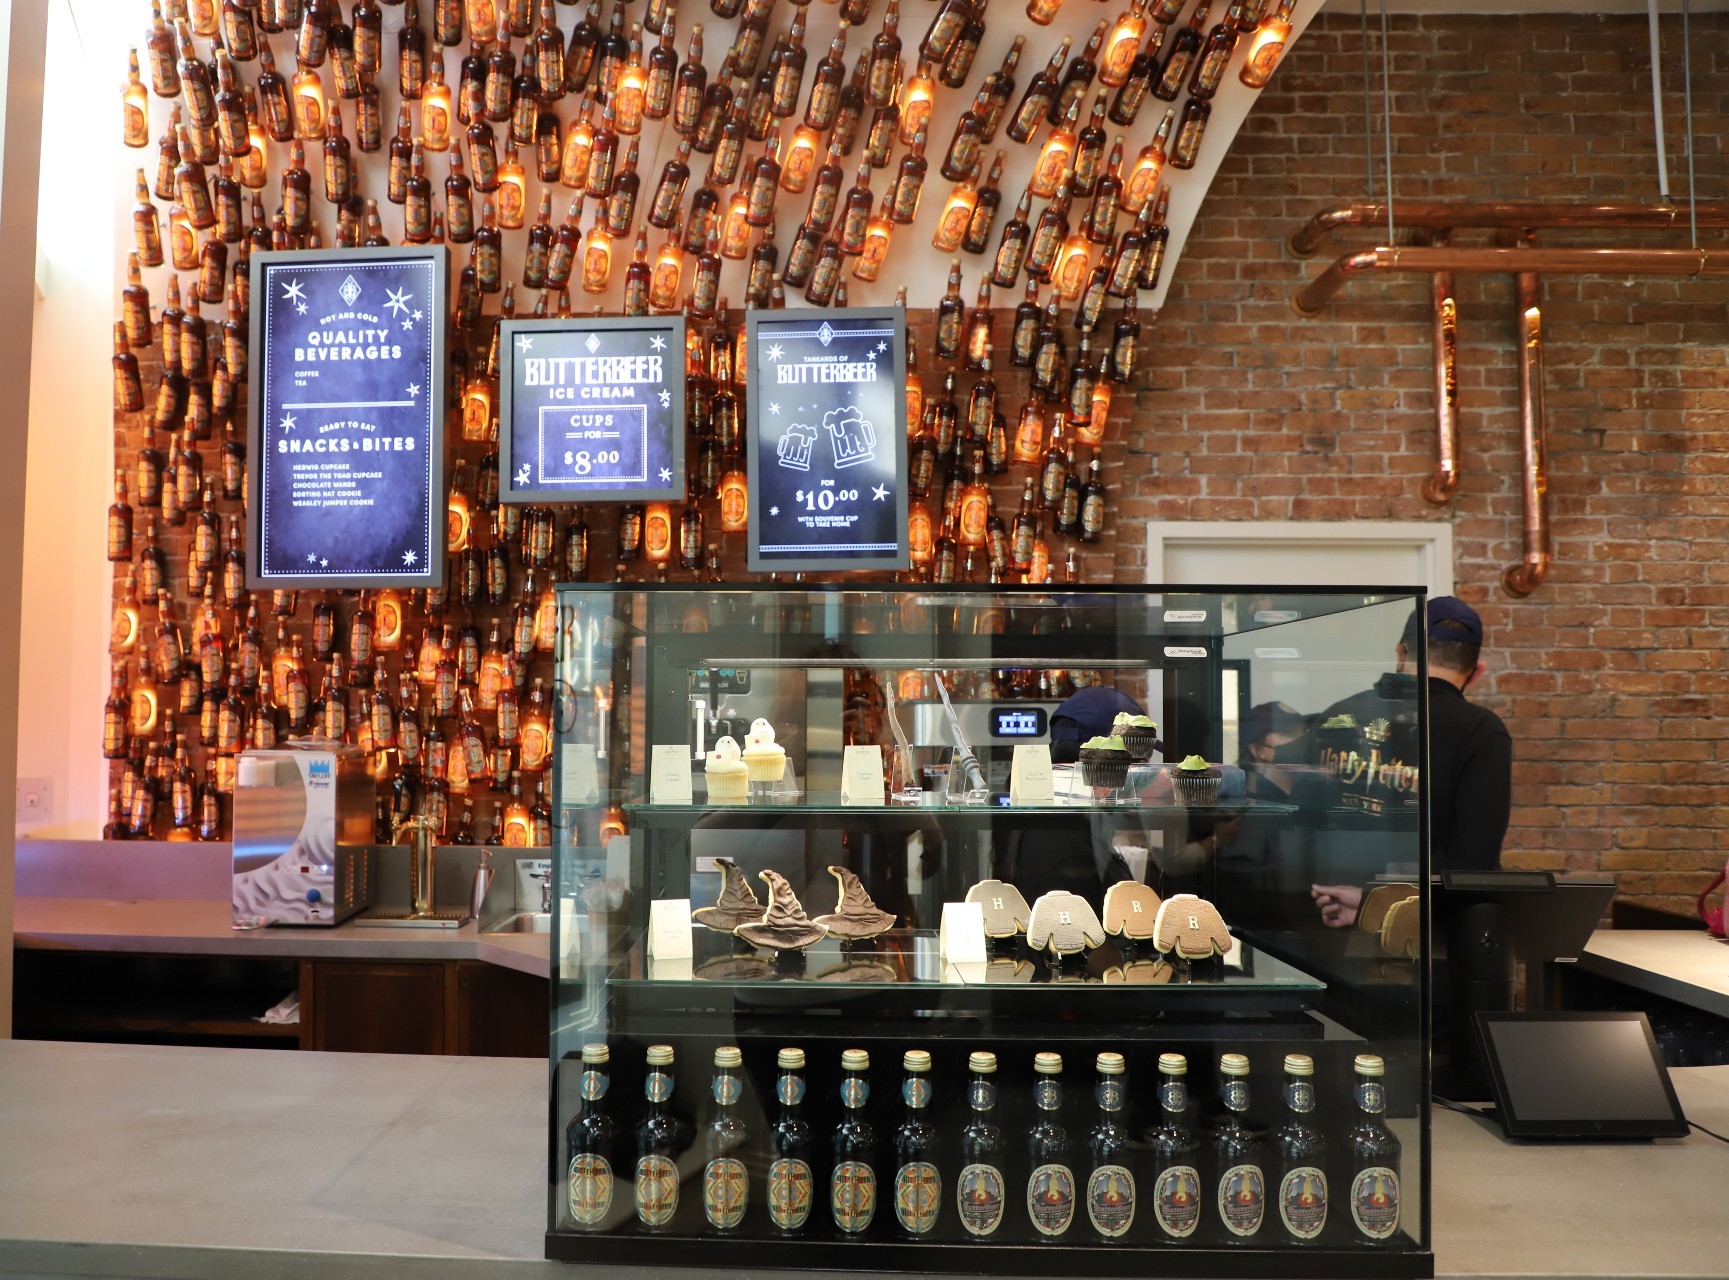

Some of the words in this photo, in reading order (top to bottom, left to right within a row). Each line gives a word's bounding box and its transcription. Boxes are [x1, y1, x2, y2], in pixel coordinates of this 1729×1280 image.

[320, 314, 336, 325] HOT
[357, 312, 378, 323] COLD
[308, 330, 388, 346] QUALITY
[294, 345, 402, 361] BEVERAGES
[524, 356, 662, 386] BUTTERBEER
[777, 362, 876, 384] BUTTERBEER
[550, 388, 574, 400] ICE
[580, 386, 634, 398] CREAM
[319, 421, 345, 434] READY
[360, 422, 376, 432] EAT
[570, 415, 614, 427] CUPS
[278, 438, 350, 453] SNACKS
[362, 437, 415, 451] BITES
[564, 450, 620, 474] $8.00
[796, 490, 858, 510] $10.00
[992, 898, 1005, 910] H
[1132, 900, 1142, 913] R
[1058, 911, 1072, 925] H
[1188, 916, 1200, 930] R
